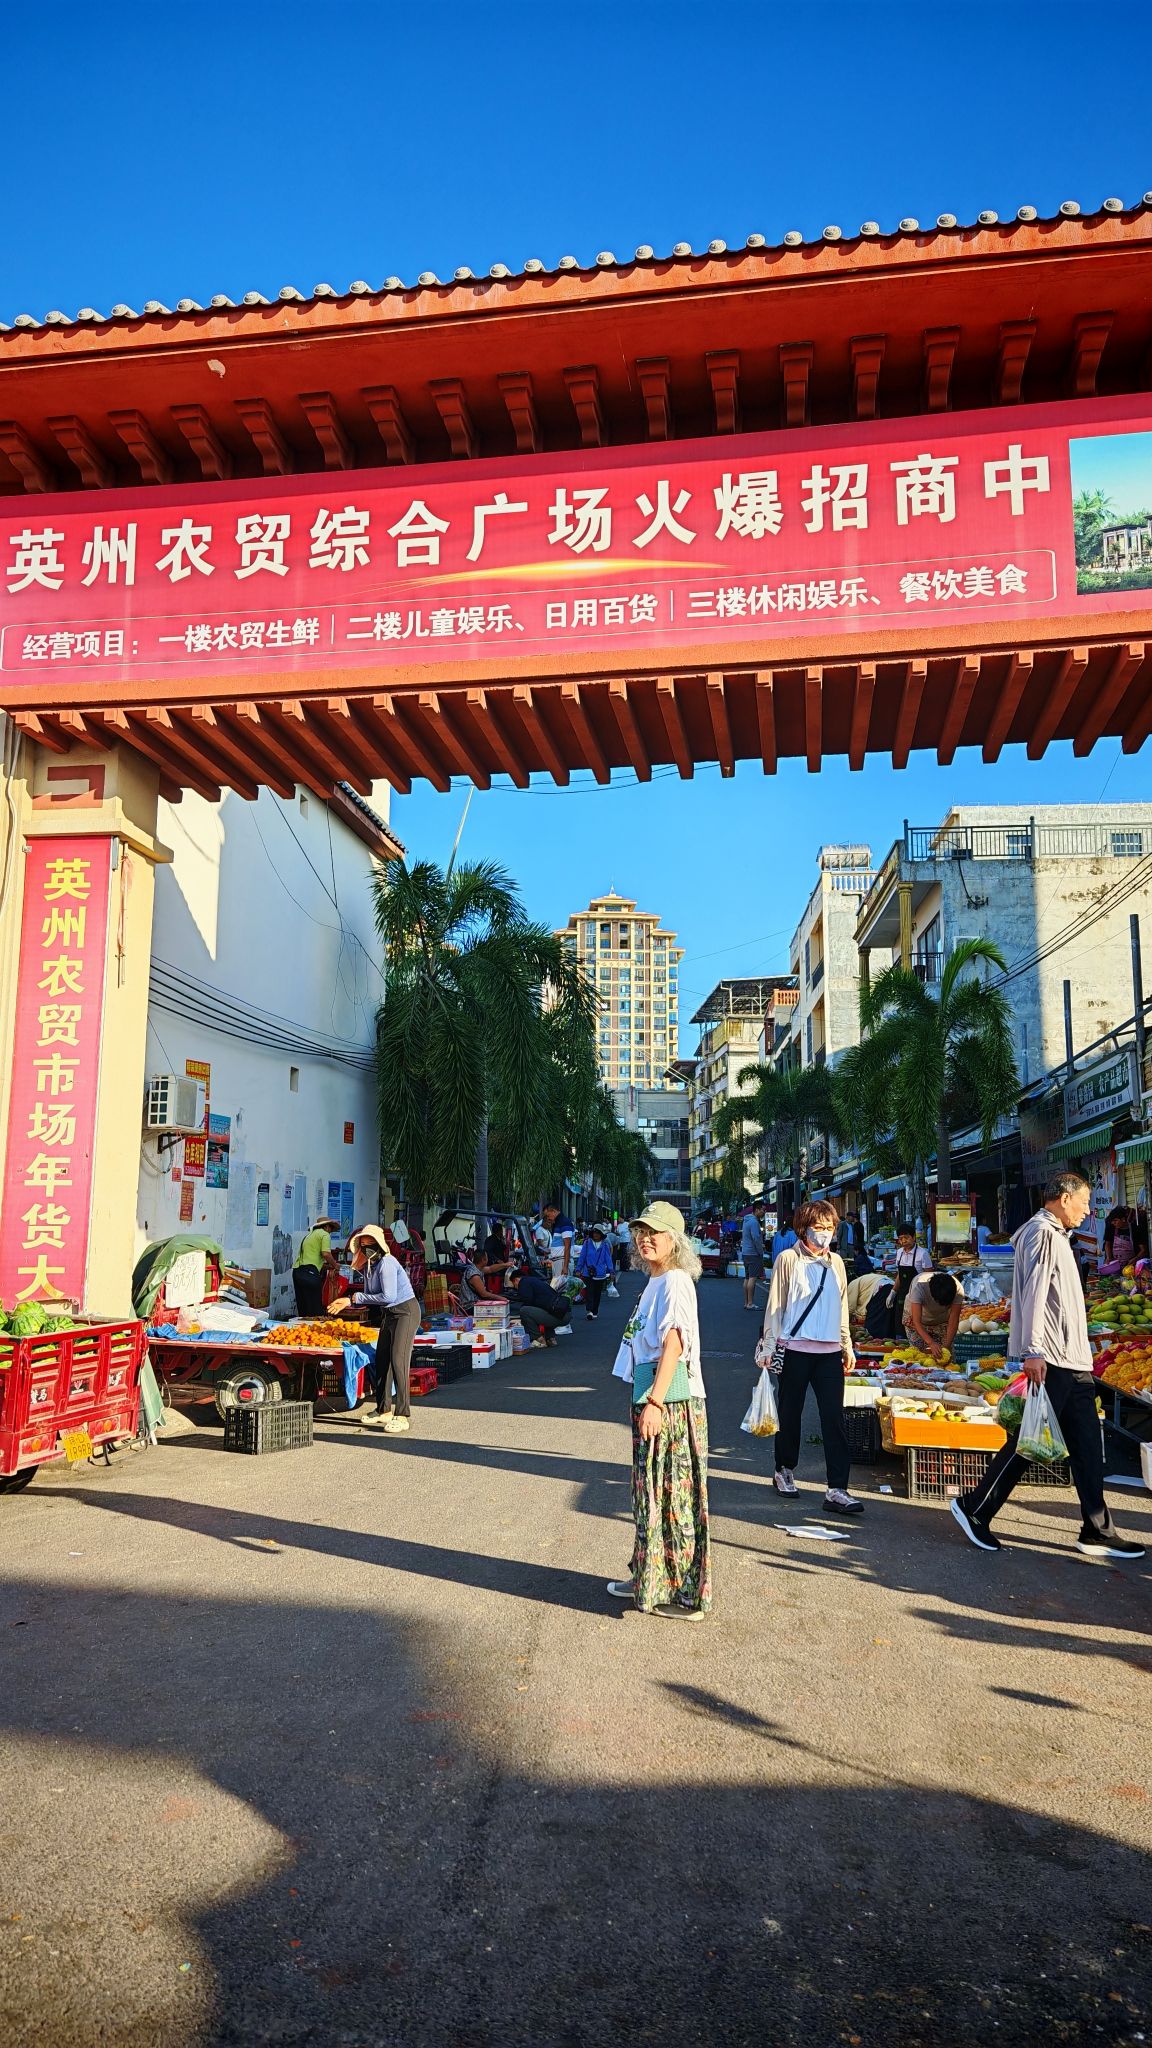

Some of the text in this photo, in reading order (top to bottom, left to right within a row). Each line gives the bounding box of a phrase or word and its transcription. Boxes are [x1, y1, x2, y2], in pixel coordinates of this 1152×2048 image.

[6, 444, 1052, 594] 英州农贸综合广场火爆招商中
[158, 616, 321, 654] 一楼农贸生鲜
[16, 859, 92, 1302] 英州农贸市场年货大
